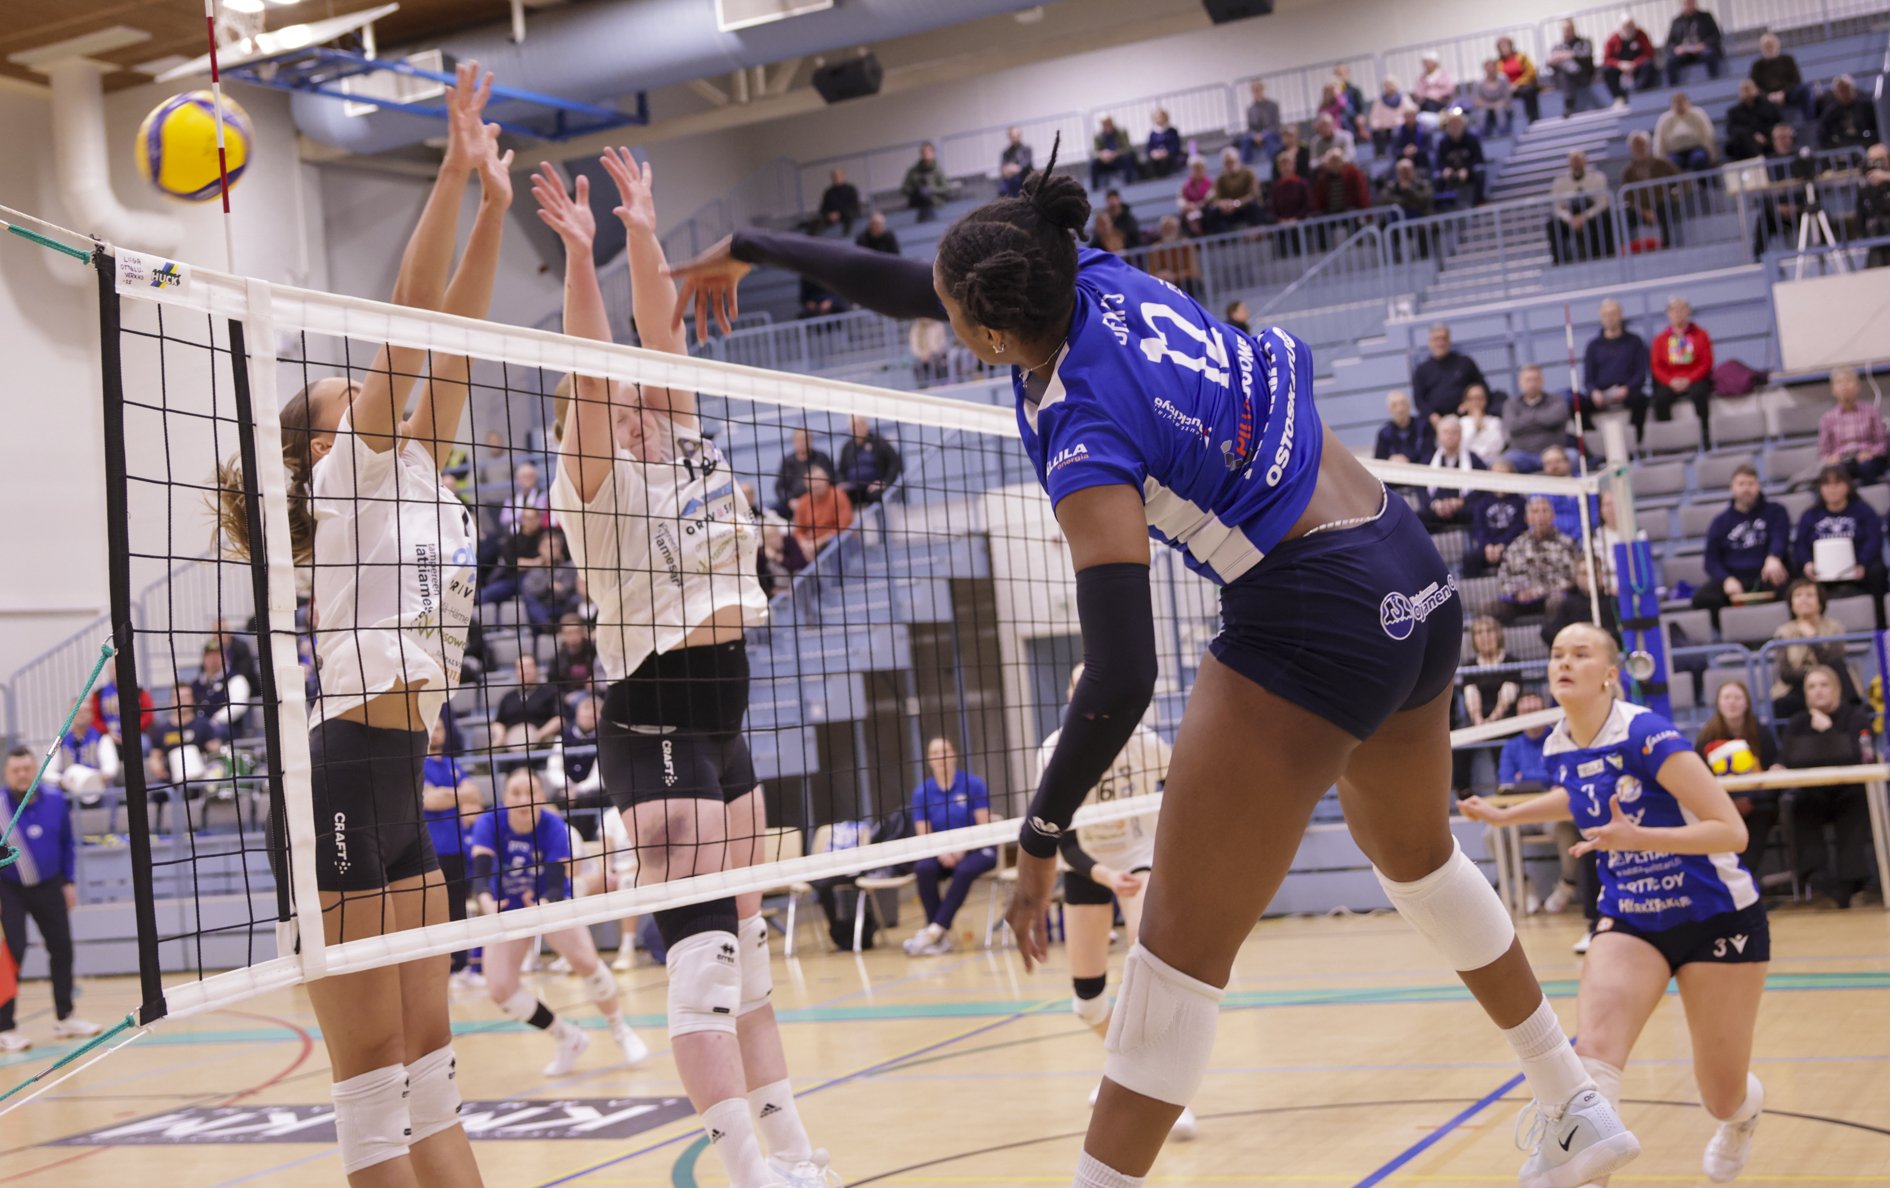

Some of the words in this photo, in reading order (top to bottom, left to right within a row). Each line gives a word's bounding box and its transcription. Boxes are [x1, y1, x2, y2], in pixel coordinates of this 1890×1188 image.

[151, 270, 181, 287] HUCK
[1413, 585, 1452, 623] Ojanen
[662, 740, 674, 776] CRAFT
[334, 812, 347, 861] CRAFT
[1713, 937, 1728, 958] 3
